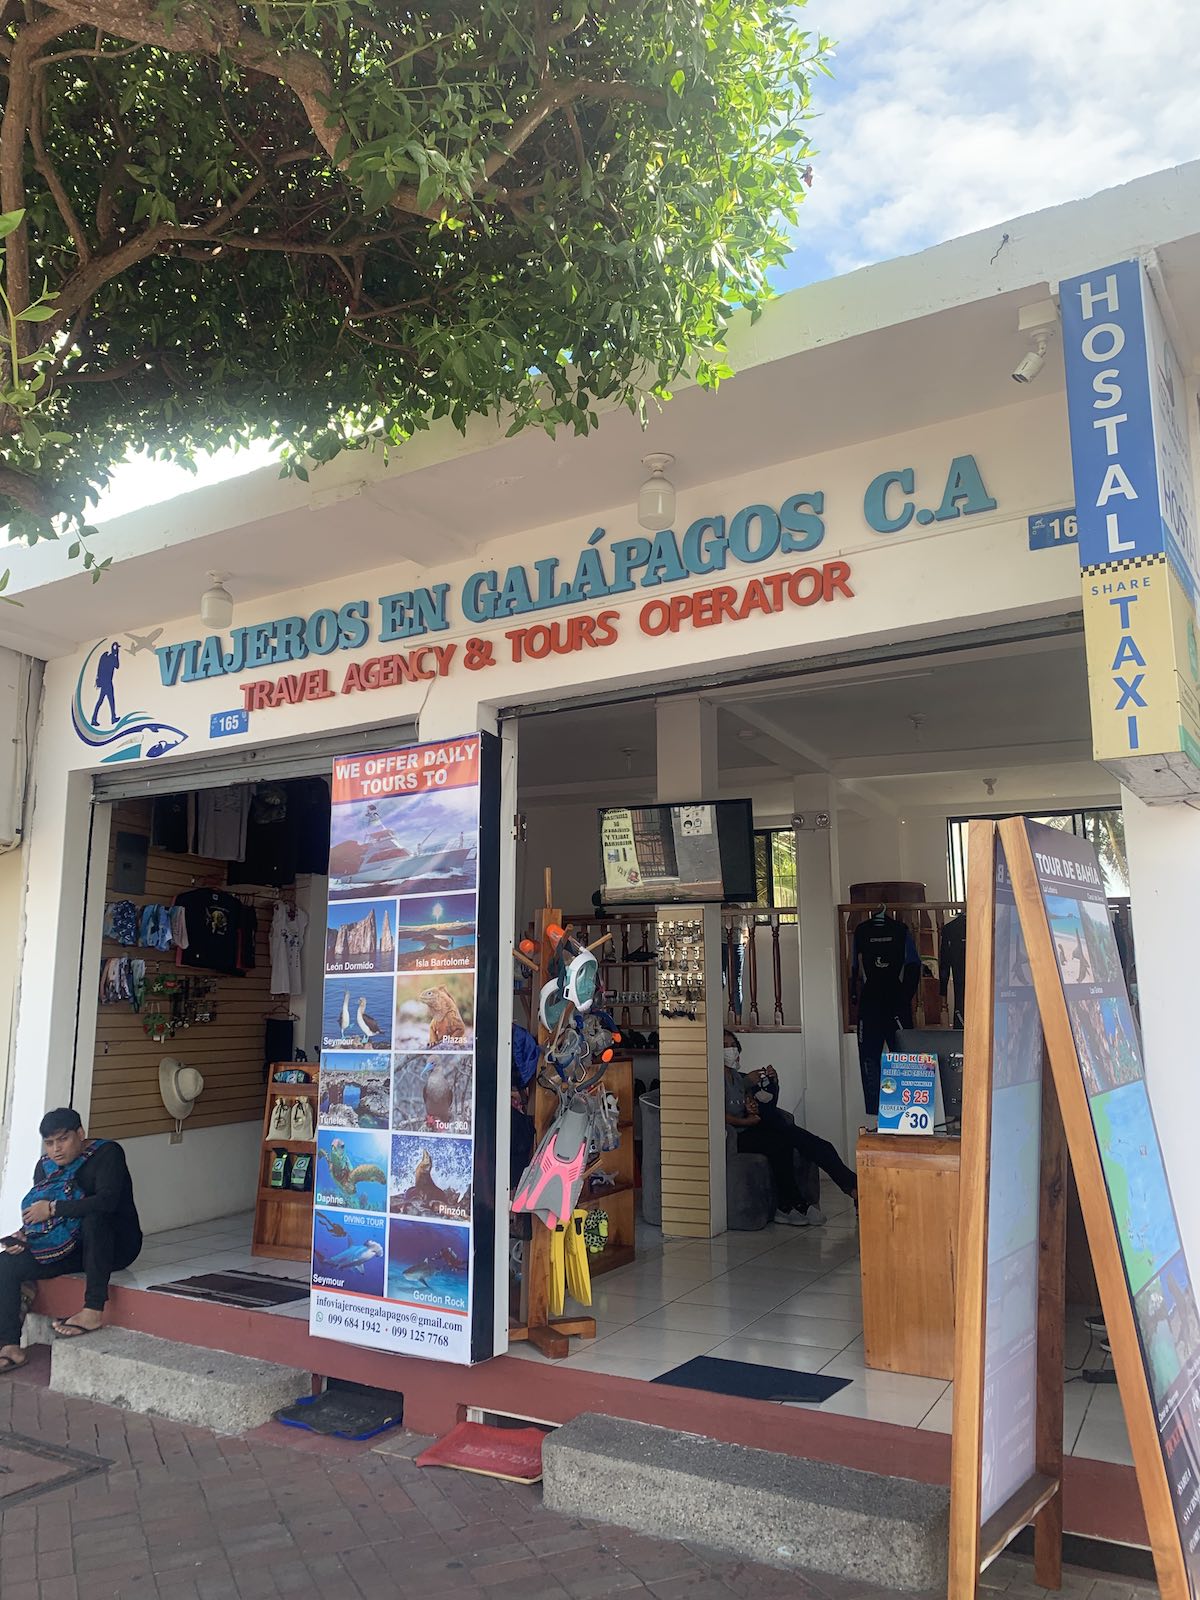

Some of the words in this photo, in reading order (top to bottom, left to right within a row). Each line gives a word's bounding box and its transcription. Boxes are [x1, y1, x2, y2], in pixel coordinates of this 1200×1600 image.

[1080, 274, 1139, 554] HOSTAL
[156, 600, 370, 686] VIAJEROS
[378, 582, 451, 642] EN
[462, 491, 825, 623] GALÁPAGOS
[863, 454, 998, 534] C.A
[1091, 577, 1151, 596] SHARE
[240, 668, 335, 712] TRAVEL
[342, 643, 457, 694] AGENCY
[463, 638, 496, 671] &
[505, 611, 620, 663] TOURS
[639, 560, 855, 637] OPERATOR
[1110, 595, 1148, 750] TAXI
[219, 714, 239, 732] 165
[336, 762, 360, 781] WE
[364, 755, 418, 776] OFFER
[424, 743, 477, 767] DAILY
[360, 773, 418, 796] TOURS
[423, 769, 447, 786] TO
[1035, 852, 1064, 878] TOUR
[1062, 859, 1076, 880] DE
[1075, 862, 1101, 886] BAHÍA
[326, 962, 344, 971] León
[344, 961, 374, 970] Dormido
[416, 958, 429, 968] Isla
[430, 956, 470, 967] Bartolomé
[323, 1037, 354, 1047] Seymour
[442, 1035, 468, 1045] Plazas
[885, 1053, 934, 1064] TICKET
[913, 1088, 930, 1105] 25
[435, 1119, 452, 1130] Tour
[453, 1119, 468, 1130] 360
[316, 1192, 344, 1204] Daphne
[439, 1204, 466, 1217] Pinzón
[343, 1214, 366, 1225] DIVING
[366, 1217, 384, 1227] TOUR
[312, 1274, 345, 1288] Seymour
[413, 1290, 443, 1304] Gordon
[445, 1295, 465, 1308] Rock
[316, 1295, 463, 1333] infoviajerosengalapagos@gmail.com
[328, 1313, 342, 1326] 099
[344, 1316, 359, 1328] 684
[361, 1319, 381, 1334] 1942
[392, 1326, 407, 1339] 099
[410, 1330, 425, 1343] 125
[428, 1333, 449, 1348] 7768
